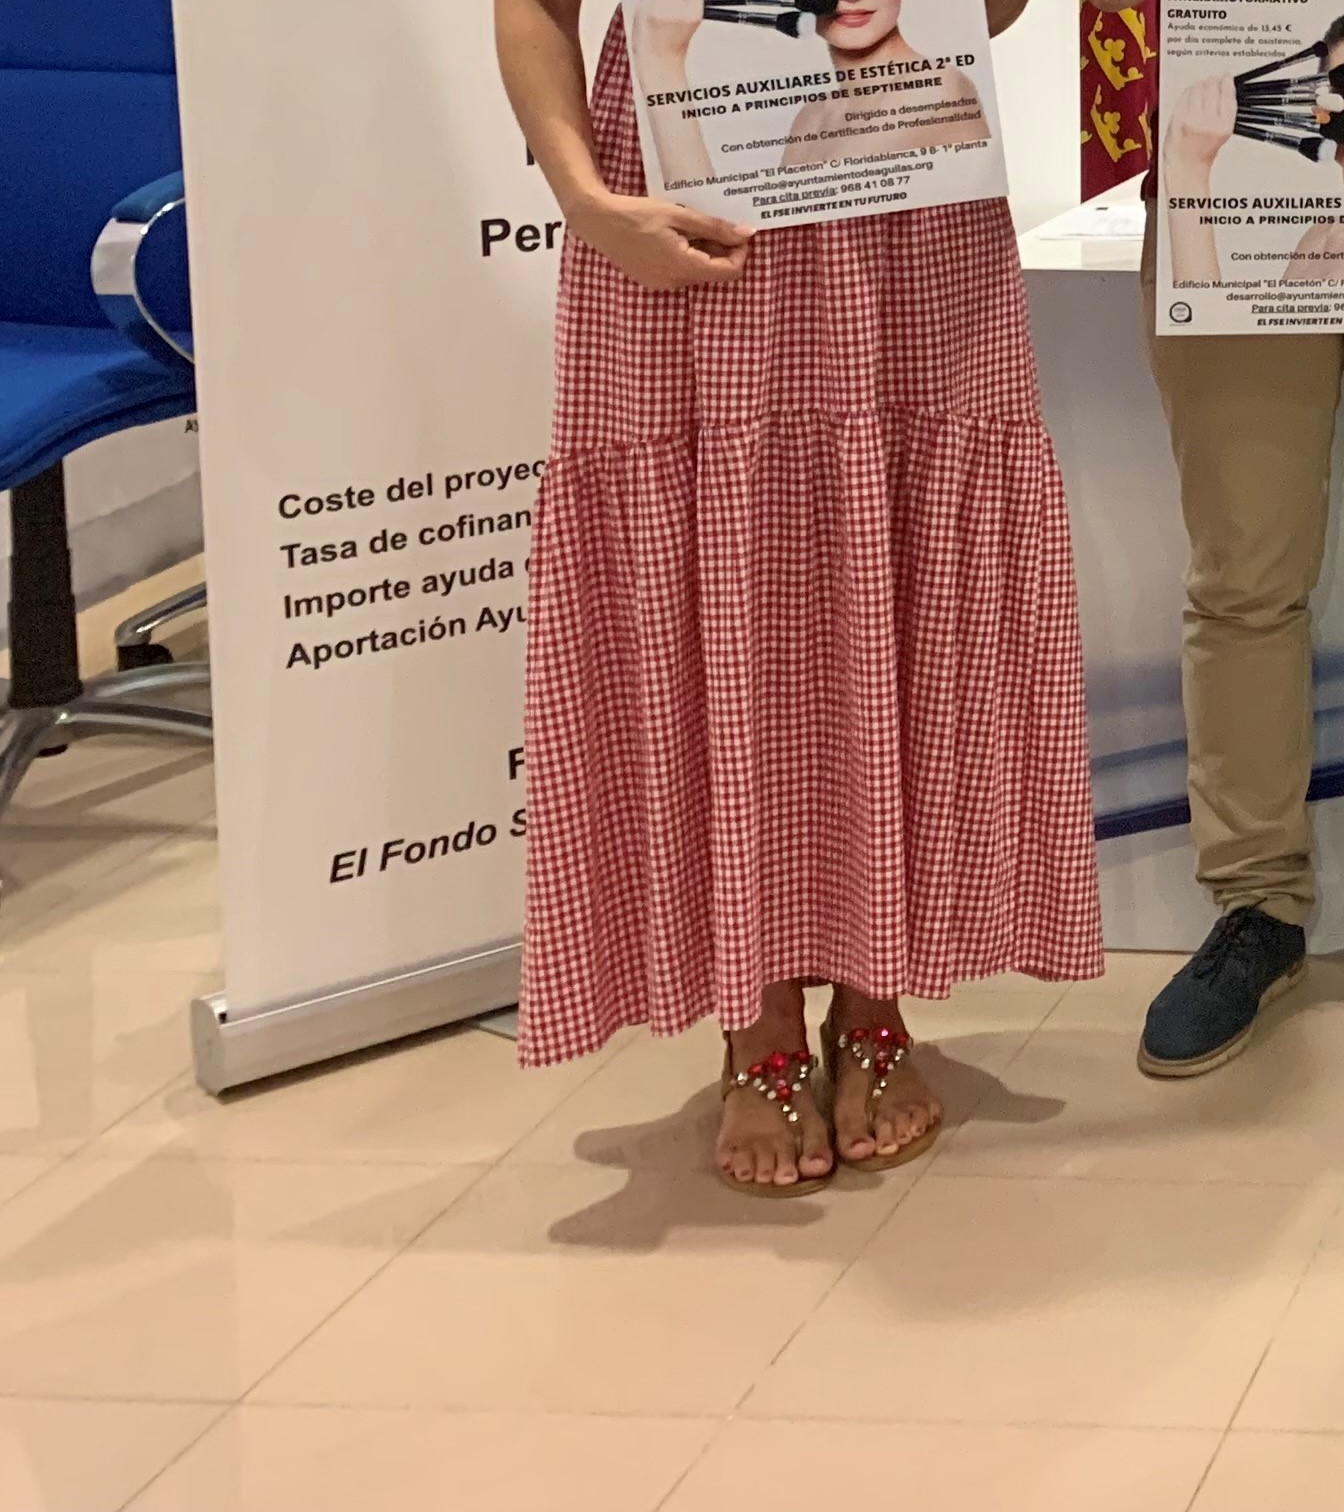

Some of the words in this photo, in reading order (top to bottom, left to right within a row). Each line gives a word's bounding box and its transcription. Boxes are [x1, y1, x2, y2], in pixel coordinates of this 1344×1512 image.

[646, 85, 731, 106] SERVICIOS
[735, 72, 831, 95] AUXILIARES
[834, 68, 856, 82] DE
[859, 59, 932, 79] ESTÉTICA
[955, 54, 975, 66] ED
[681, 104, 727, 118] INICIO
[731, 103, 741, 113] A
[744, 92, 828, 110] PRINCIPIOS
[830, 88, 849, 99] DE
[853, 76, 942, 96] SEPTIEMBRE
[1168, 197, 1248, 209] SERVICIOS
[1251, 197, 1342, 209] AUXILIARES
[278, 484, 376, 520] Coste
[386, 473, 434, 503] del
[445, 459, 546, 499] proyec
[280, 539, 358, 569] Tasa
[369, 528, 408, 555] de
[418, 507, 533, 547] cofinan
[283, 576, 411, 620] Importe
[421, 556, 515, 599] ayuda
[285, 614, 466, 670] Aportación
[329, 847, 368, 884] El
[379, 820, 497, 873] Fondo
